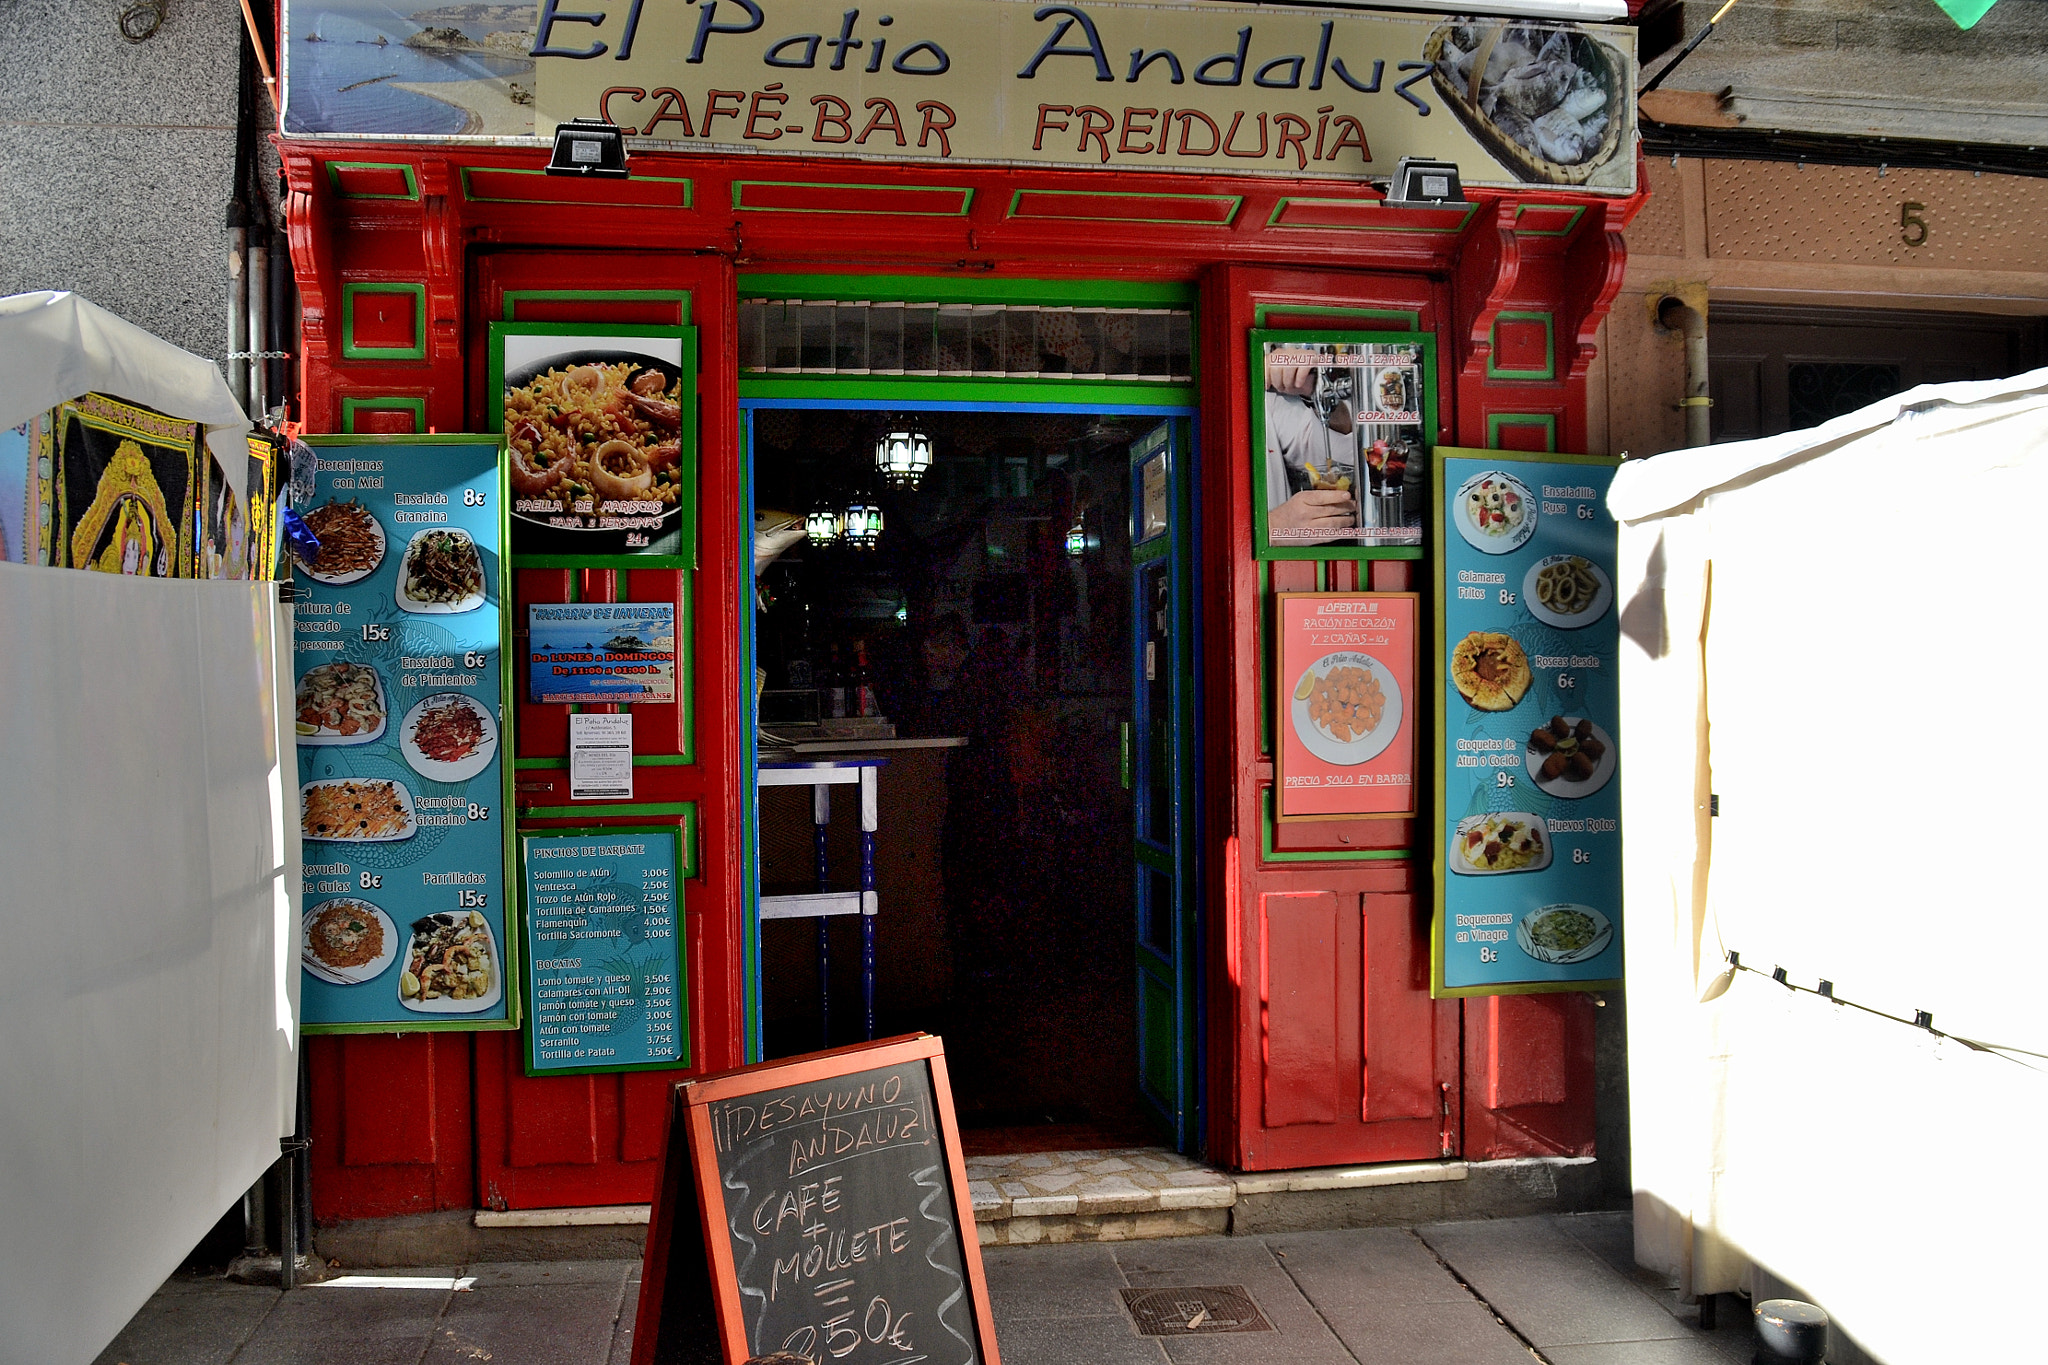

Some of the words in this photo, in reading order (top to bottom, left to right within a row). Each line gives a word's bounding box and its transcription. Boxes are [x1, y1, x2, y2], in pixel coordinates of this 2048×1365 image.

[529, 0, 644, 61] El
[685, 0, 951, 75] Patio
[1016, 5, 1436, 117] Andaluz
[599, 82, 957, 158] CAFÉ-BAR
[1032, 103, 1373, 170] FREIDURÍA
[1900, 202, 1928, 247] 5
[1270, 354, 1314, 366] VERMUT
[1318, 354, 1333, 364] DE
[1336, 354, 1365, 366] GRIFO
[1358, 411, 1386, 421] COPA
[317, 458, 383, 473] Berenjenas
[333, 478, 355, 489] con
[358, 476, 384, 489] Miel
[394, 492, 448, 506] Ensalada
[463, 488, 486, 507] 8€
[1542, 485, 1596, 499] Ensaladilla
[516, 500, 563, 512] PAELLA
[574, 500, 594, 512] DE
[600, 500, 663, 514] MARISCOS
[1543, 500, 1568, 515] Rusa
[1577, 504, 1595, 519] 6€
[550, 516, 584, 529] PARA
[600, 516, 663, 530] PERSONAS
[1458, 570, 1506, 584] Calamares
[1458, 586, 1486, 600] Fritos
[1499, 589, 1516, 606] 8€
[335, 602, 351, 614] de
[594, 607, 612, 620] DE
[1304, 617, 1342, 629] RACIÓN
[1344, 618, 1358, 628] DE
[1360, 617, 1396, 629] CAZÓN
[362, 624, 390, 642] 15€
[1330, 632, 1368, 645] CAÑAS
[300, 640, 345, 653] personas
[402, 656, 454, 669] Ensalada
[464, 651, 486, 670] 6€
[532, 653, 549, 663] De
[550, 652, 593, 662] LUNES
[605, 652, 674, 662] DOMINGOS
[1536, 655, 1568, 668] Roscas
[1570, 655, 1600, 668] desde
[552, 666, 568, 675] De
[571, 666, 602, 675] 11:00
[604, 667, 612, 675] a
[614, 666, 646, 675] 01:00
[402, 674, 416, 686] de
[420, 674, 477, 687] Pimientos
[1558, 673, 1576, 689] 6€
[1457, 738, 1502, 752] Croquetas
[1504, 738, 1516, 750] de
[1480, 758, 1486, 768] o
[1489, 754, 1520, 767] Cocido
[1286, 776, 1320, 786] PRECIO
[1326, 775, 1352, 786] SOLO
[1358, 774, 1374, 784] EN
[1376, 774, 1411, 784] BARRA
[1496, 771, 1516, 788] 9€
[467, 802, 490, 821] 8€
[1548, 818, 1584, 832] Huevos
[1587, 818, 1616, 834] Rotos
[534, 847, 579, 858] PINCHOS
[582, 846, 596, 856] DE
[599, 844, 645, 858] BARBATE
[1572, 848, 1591, 864] 8€
[360, 871, 382, 890] 8€
[423, 872, 486, 886] Parrilladas
[534, 870, 574, 880] Solomillo
[576, 868, 588, 878] de
[318, 880, 351, 894] Gulas
[534, 882, 576, 892] Ventresca
[458, 890, 488, 908] 15€
[535, 895, 558, 904] Trozo
[561, 894, 572, 903] de
[597, 892, 617, 903] Rojo
[575, 906, 586, 914] de
[588, 904, 636, 914] Camarones
[1456, 913, 1513, 928] Boquerones
[536, 932, 568, 941] Tortilla
[570, 930, 622, 940] Sacromonte
[1456, 932, 1470, 943] en
[1471, 929, 1508, 944] Vinagre
[1480, 946, 1498, 963] 8€
[536, 958, 582, 970] BOCATAS
[538, 977, 562, 986] Lomo
[564, 976, 594, 986] tomate
[605, 974, 631, 986] queso
[538, 989, 582, 998] Calamares
[584, 988, 600, 996] con
[538, 1000, 566, 1012] Jamón
[568, 1000, 599, 1010] tomate
[609, 998, 635, 1010] queso
[539, 1013, 567, 1024] Jamón
[569, 1013, 585, 1022] con
[588, 1011, 618, 1020] tomate
[540, 1024, 560, 1035] Atún
[562, 1025, 578, 1034] con
[580, 1024, 611, 1032] tomate
[540, 1036, 580, 1048] Serranito
[541, 1050, 572, 1060] Tortilla
[574, 1049, 586, 1058] de
[588, 1048, 616, 1057] Patata
[771, 1217, 910, 1302] MOLLETE
